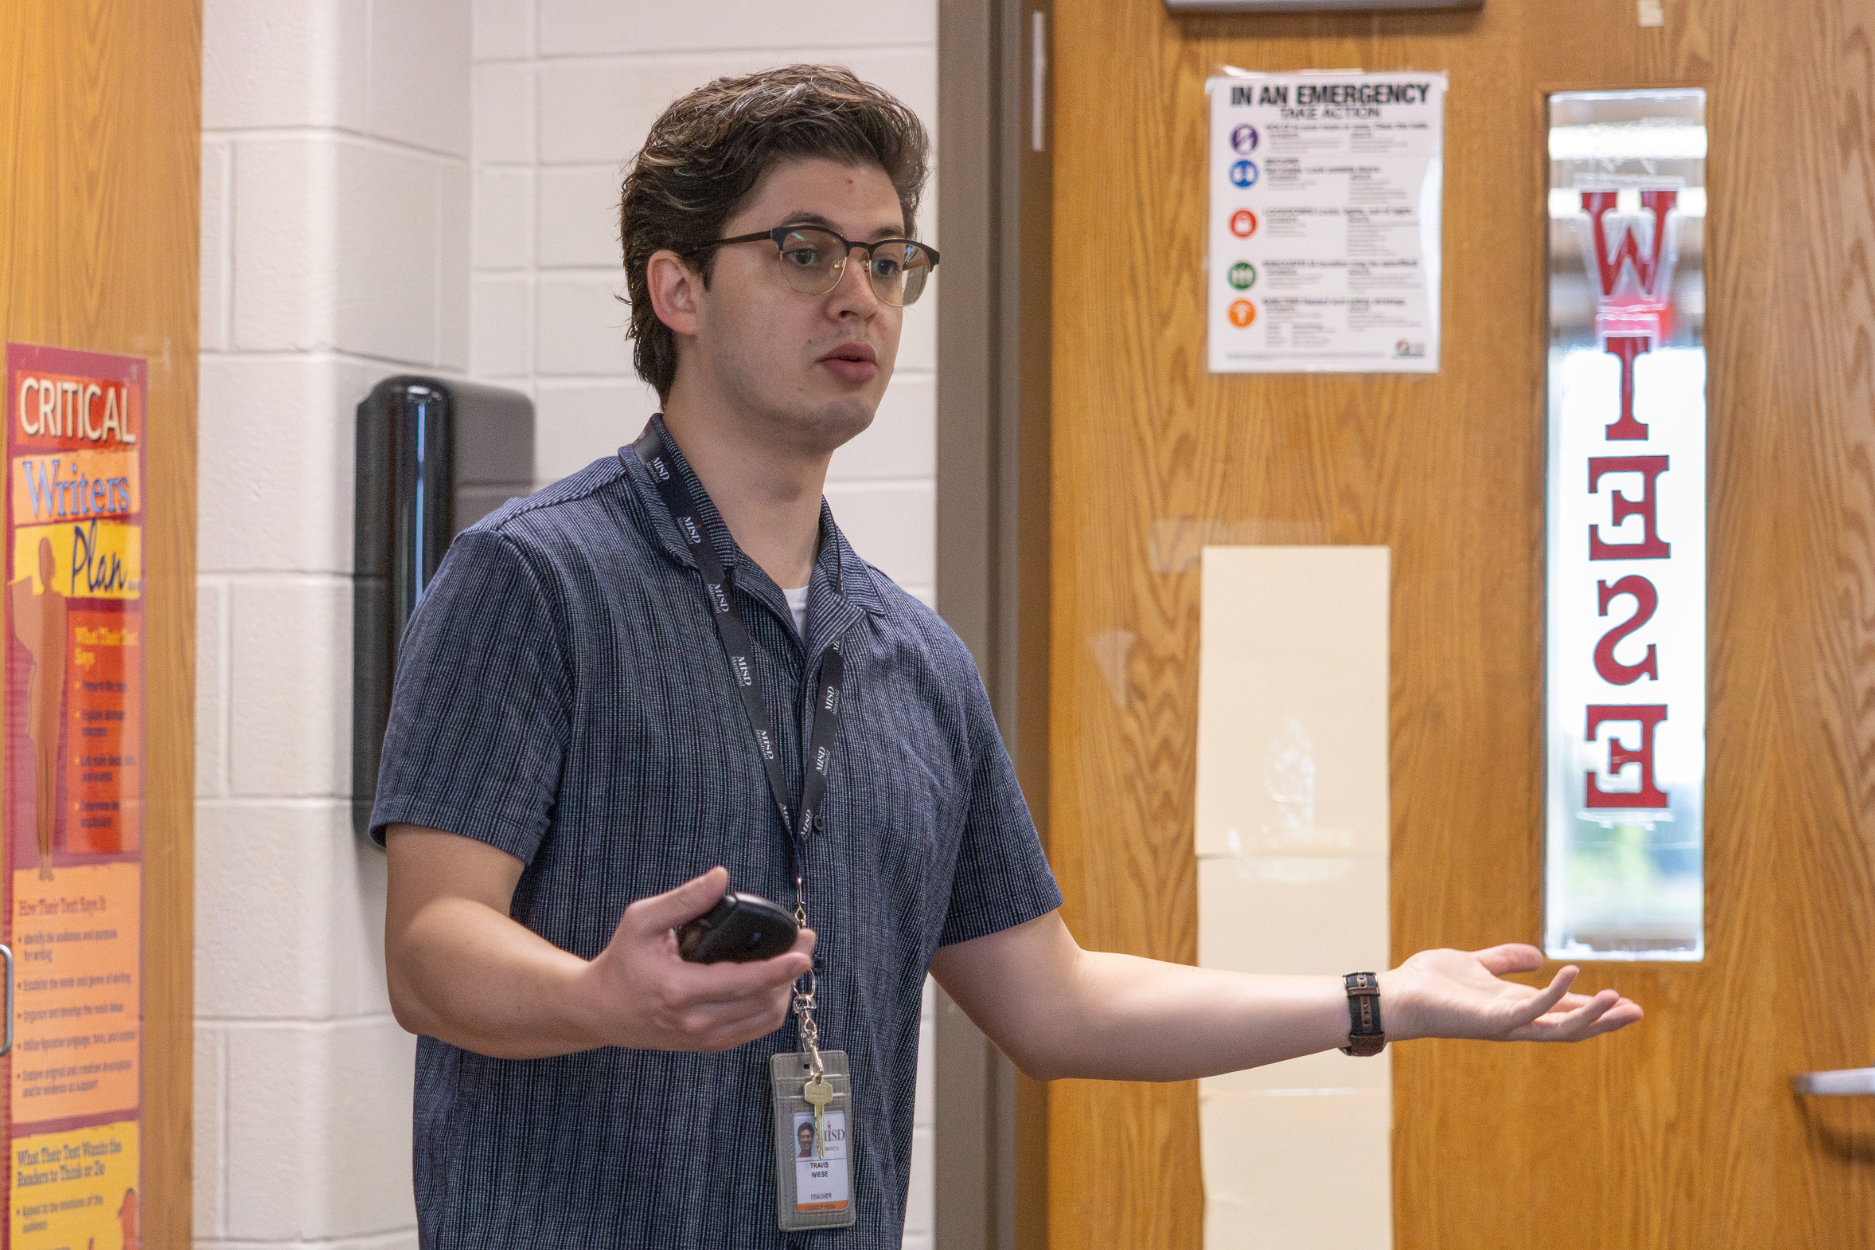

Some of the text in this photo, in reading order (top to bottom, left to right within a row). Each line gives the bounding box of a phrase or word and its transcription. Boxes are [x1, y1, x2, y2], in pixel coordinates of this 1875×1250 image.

[1230, 83, 1430, 107] IN AN EMERGENCY
[1322, 106, 1381, 119] ACTION
[20, 377, 136, 445] CRITICAL
[651, 457, 670, 480] MISD
[22, 459, 130, 518] Writers
[683, 516, 701, 543] MISD
[713, 584, 729, 612] MISD
[736, 656, 751, 686] MISD
[825, 686, 834, 712] MISD
[760, 730, 774, 760] MISD
[816, 746, 826, 772] MISD
[41, 1146, 62, 1164] Their
[810, 1193, 832, 1201] TEACHER
